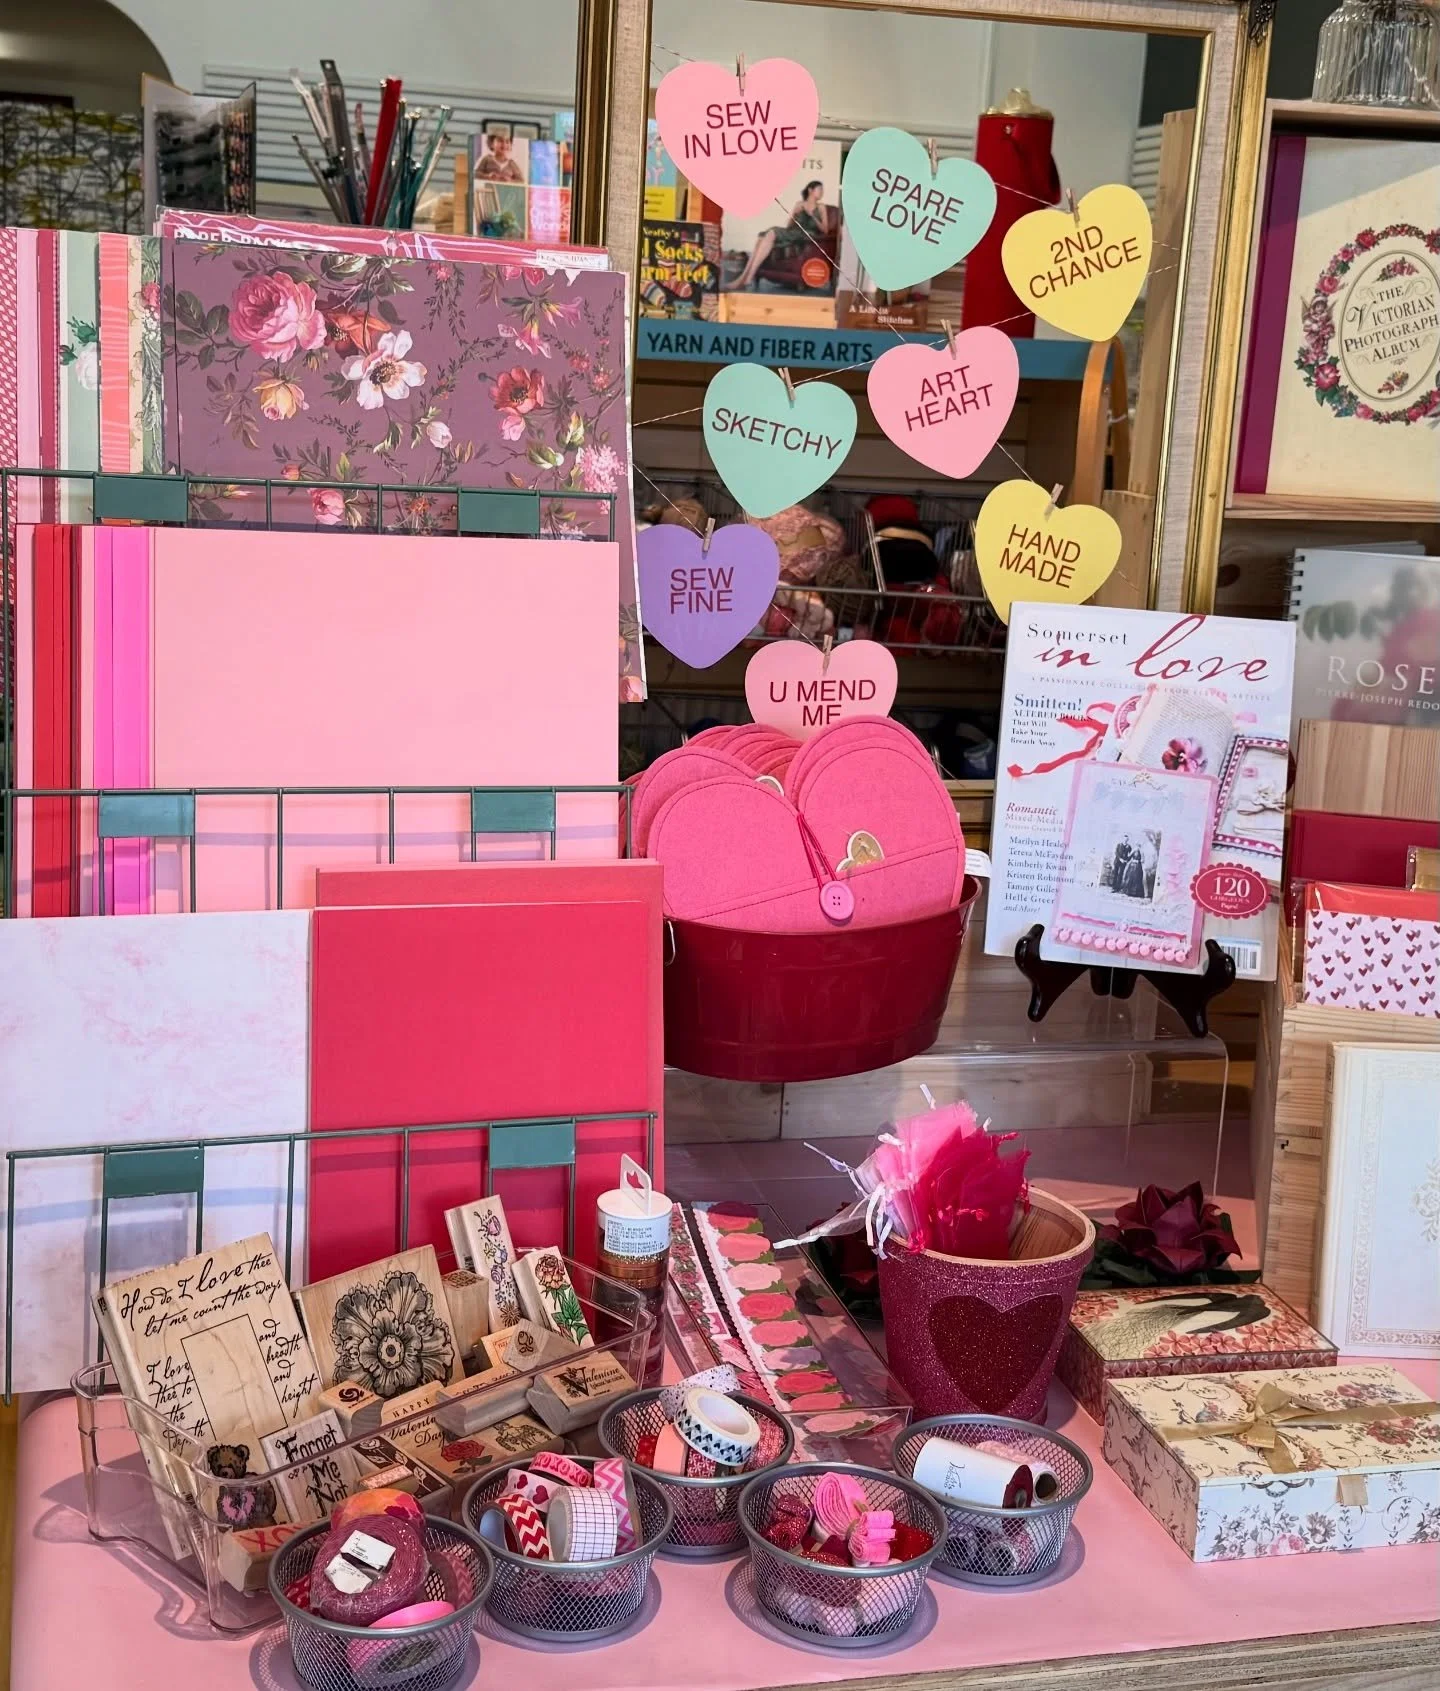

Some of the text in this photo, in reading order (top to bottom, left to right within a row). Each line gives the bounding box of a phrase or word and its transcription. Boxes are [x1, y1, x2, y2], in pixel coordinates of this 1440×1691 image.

[706, 100, 772, 129] SEW
[684, 126, 798, 159] IN LOVE
[872, 168, 964, 224] SPARE
[870, 196, 946, 245] LOVE
[655, 240, 704, 262] Socks
[1050, 225, 1104, 265] 2ND
[1028, 237, 1142, 300] CHANCE
[1377, 286, 1404, 302] THE
[1346, 294, 1435, 332] VICTORIAN
[647, 332, 873, 362] YARN AND FIBER ARTS
[1344, 314, 1439, 352] PHOTOGRAPH
[1373, 338, 1420, 362] ALBUM
[919, 365, 971, 402] ART
[905, 383, 993, 432] HEART
[711, 407, 843, 460] SKETCHY
[1008, 523, 1081, 564] HAND
[670, 566, 734, 591] SEW
[999, 547, 1076, 589] MADE
[670, 590, 734, 614] FINE
[1027, 623, 1128, 646] Somerset
[1034, 613, 1270, 682] in love
[1328, 656, 1436, 694] ROSE
[769, 679, 877, 703] U MEND
[1014, 694, 1081, 711] Smitten!
[802, 705, 842, 727] ME
[1014, 709, 1057, 719] ALTERED
[1010, 737, 1056, 748] Breath Away
[1031, 729, 1047, 737] Your
[1006, 802, 1058, 815] Romantic
[1006, 813, 1063, 825] Mixed Media
[1009, 847, 1032, 856] Teresa
[1010, 836, 1040, 847] Marilyn
[1006, 870, 1074, 883] Kristen Robinson
[1007, 859, 1067, 871] Kimberly Kwan
[1005, 893, 1028, 901] Helle
[1007, 881, 1034, 893] Tammy
[1213, 876, 1250, 898] 120
[178, 1275, 194, 1300] I
[196, 1257, 244, 1293] love
[244, 1253, 273, 1275] thee
[144, 1280, 282, 1337] let me count the ways
[259, 1318, 281, 1342] and
[266, 1335, 303, 1365] breadth
[147, 1356, 191, 1385] I love
[274, 1359, 295, 1383] and
[554, 1367, 620, 1396] Valentine
[150, 1374, 195, 1408] thee to
[281, 1373, 318, 1419] height
[163, 1401, 192, 1421] the
[392, 1398, 430, 1418] HAPPY
[275, 1424, 337, 1463] Forget
[307, 1456, 341, 1488] Me
[306, 1479, 348, 1518] Not
